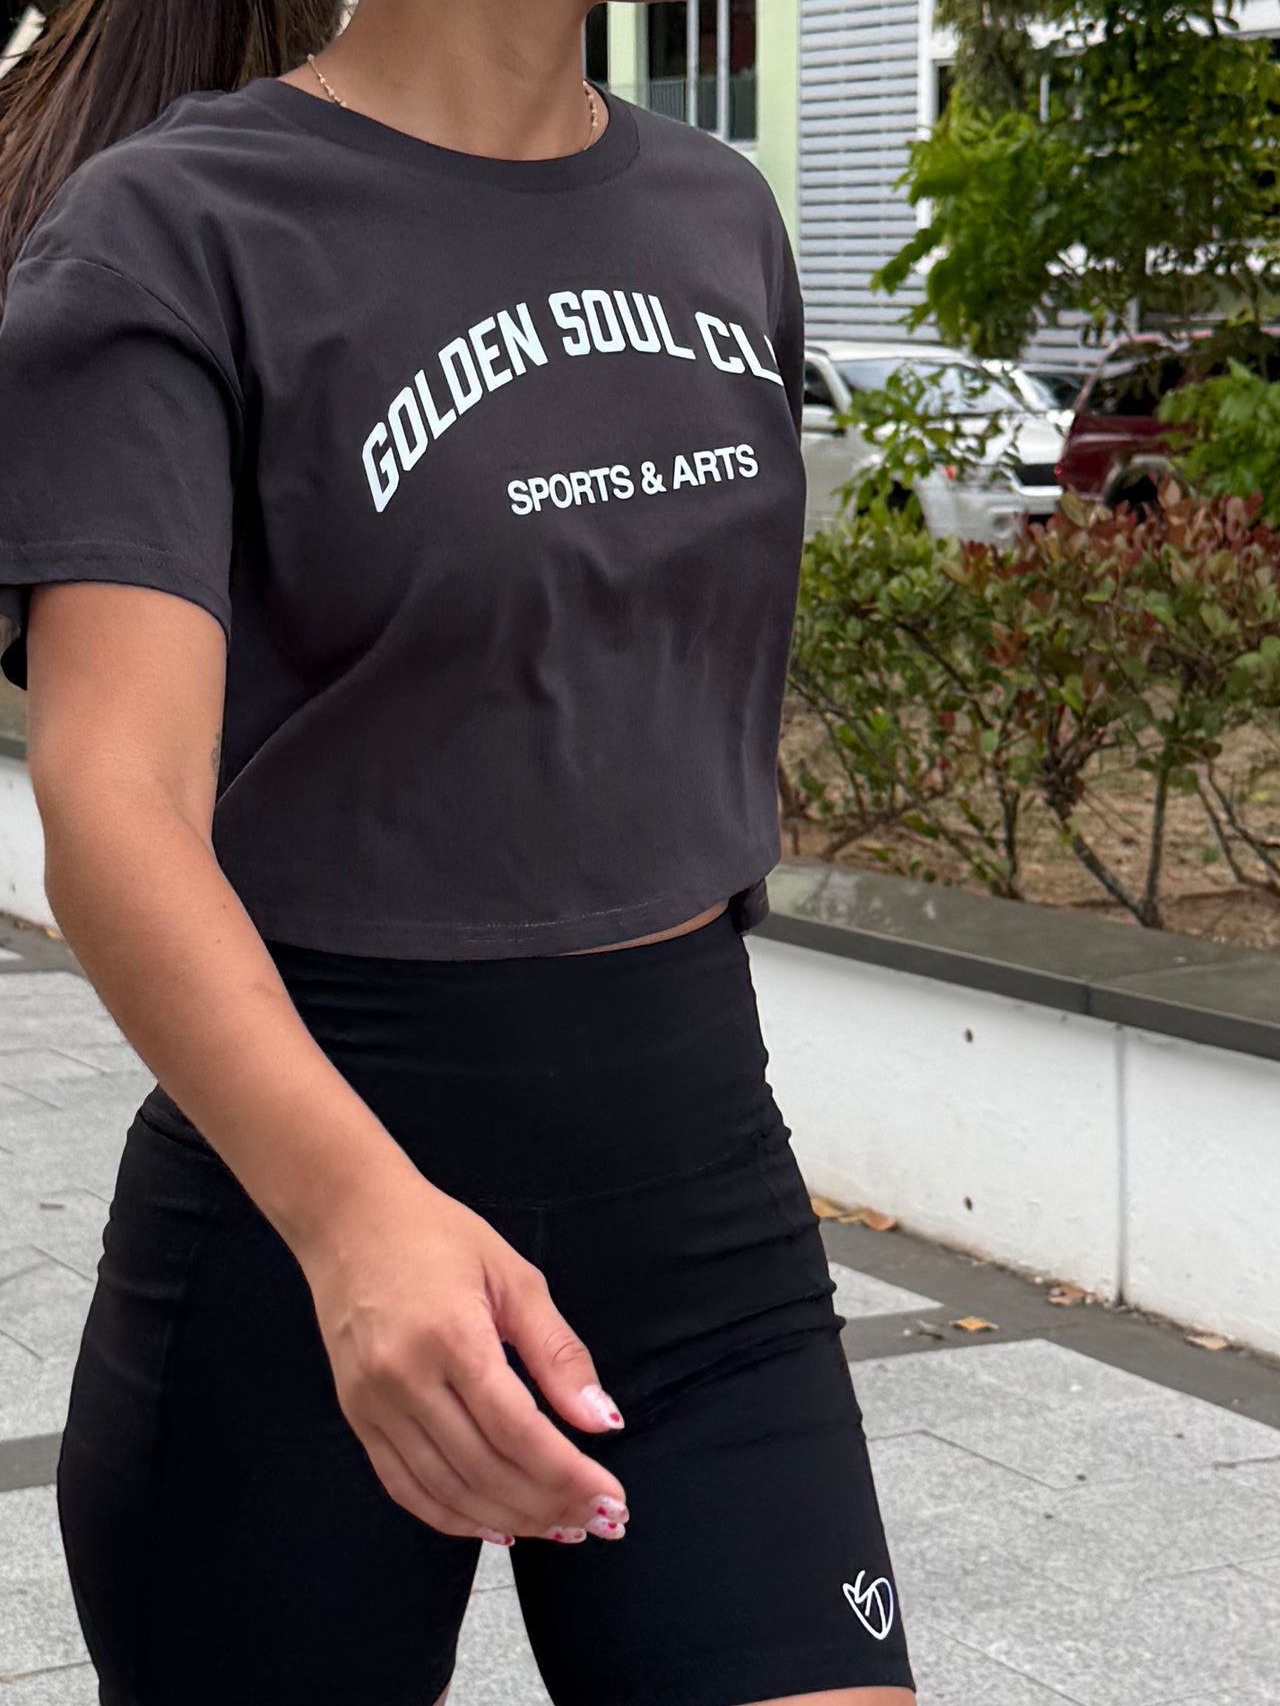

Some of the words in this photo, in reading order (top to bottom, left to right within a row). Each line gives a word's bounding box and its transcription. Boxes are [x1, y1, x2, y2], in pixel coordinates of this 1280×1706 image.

[361, 302, 549, 513] GOLDEN
[548, 289, 697, 360] SOUL
[694, 311, 784, 387] CL
[507, 464, 635, 516] SPORTS
[640, 461, 667, 495] &
[672, 443, 759, 490] ARTS
